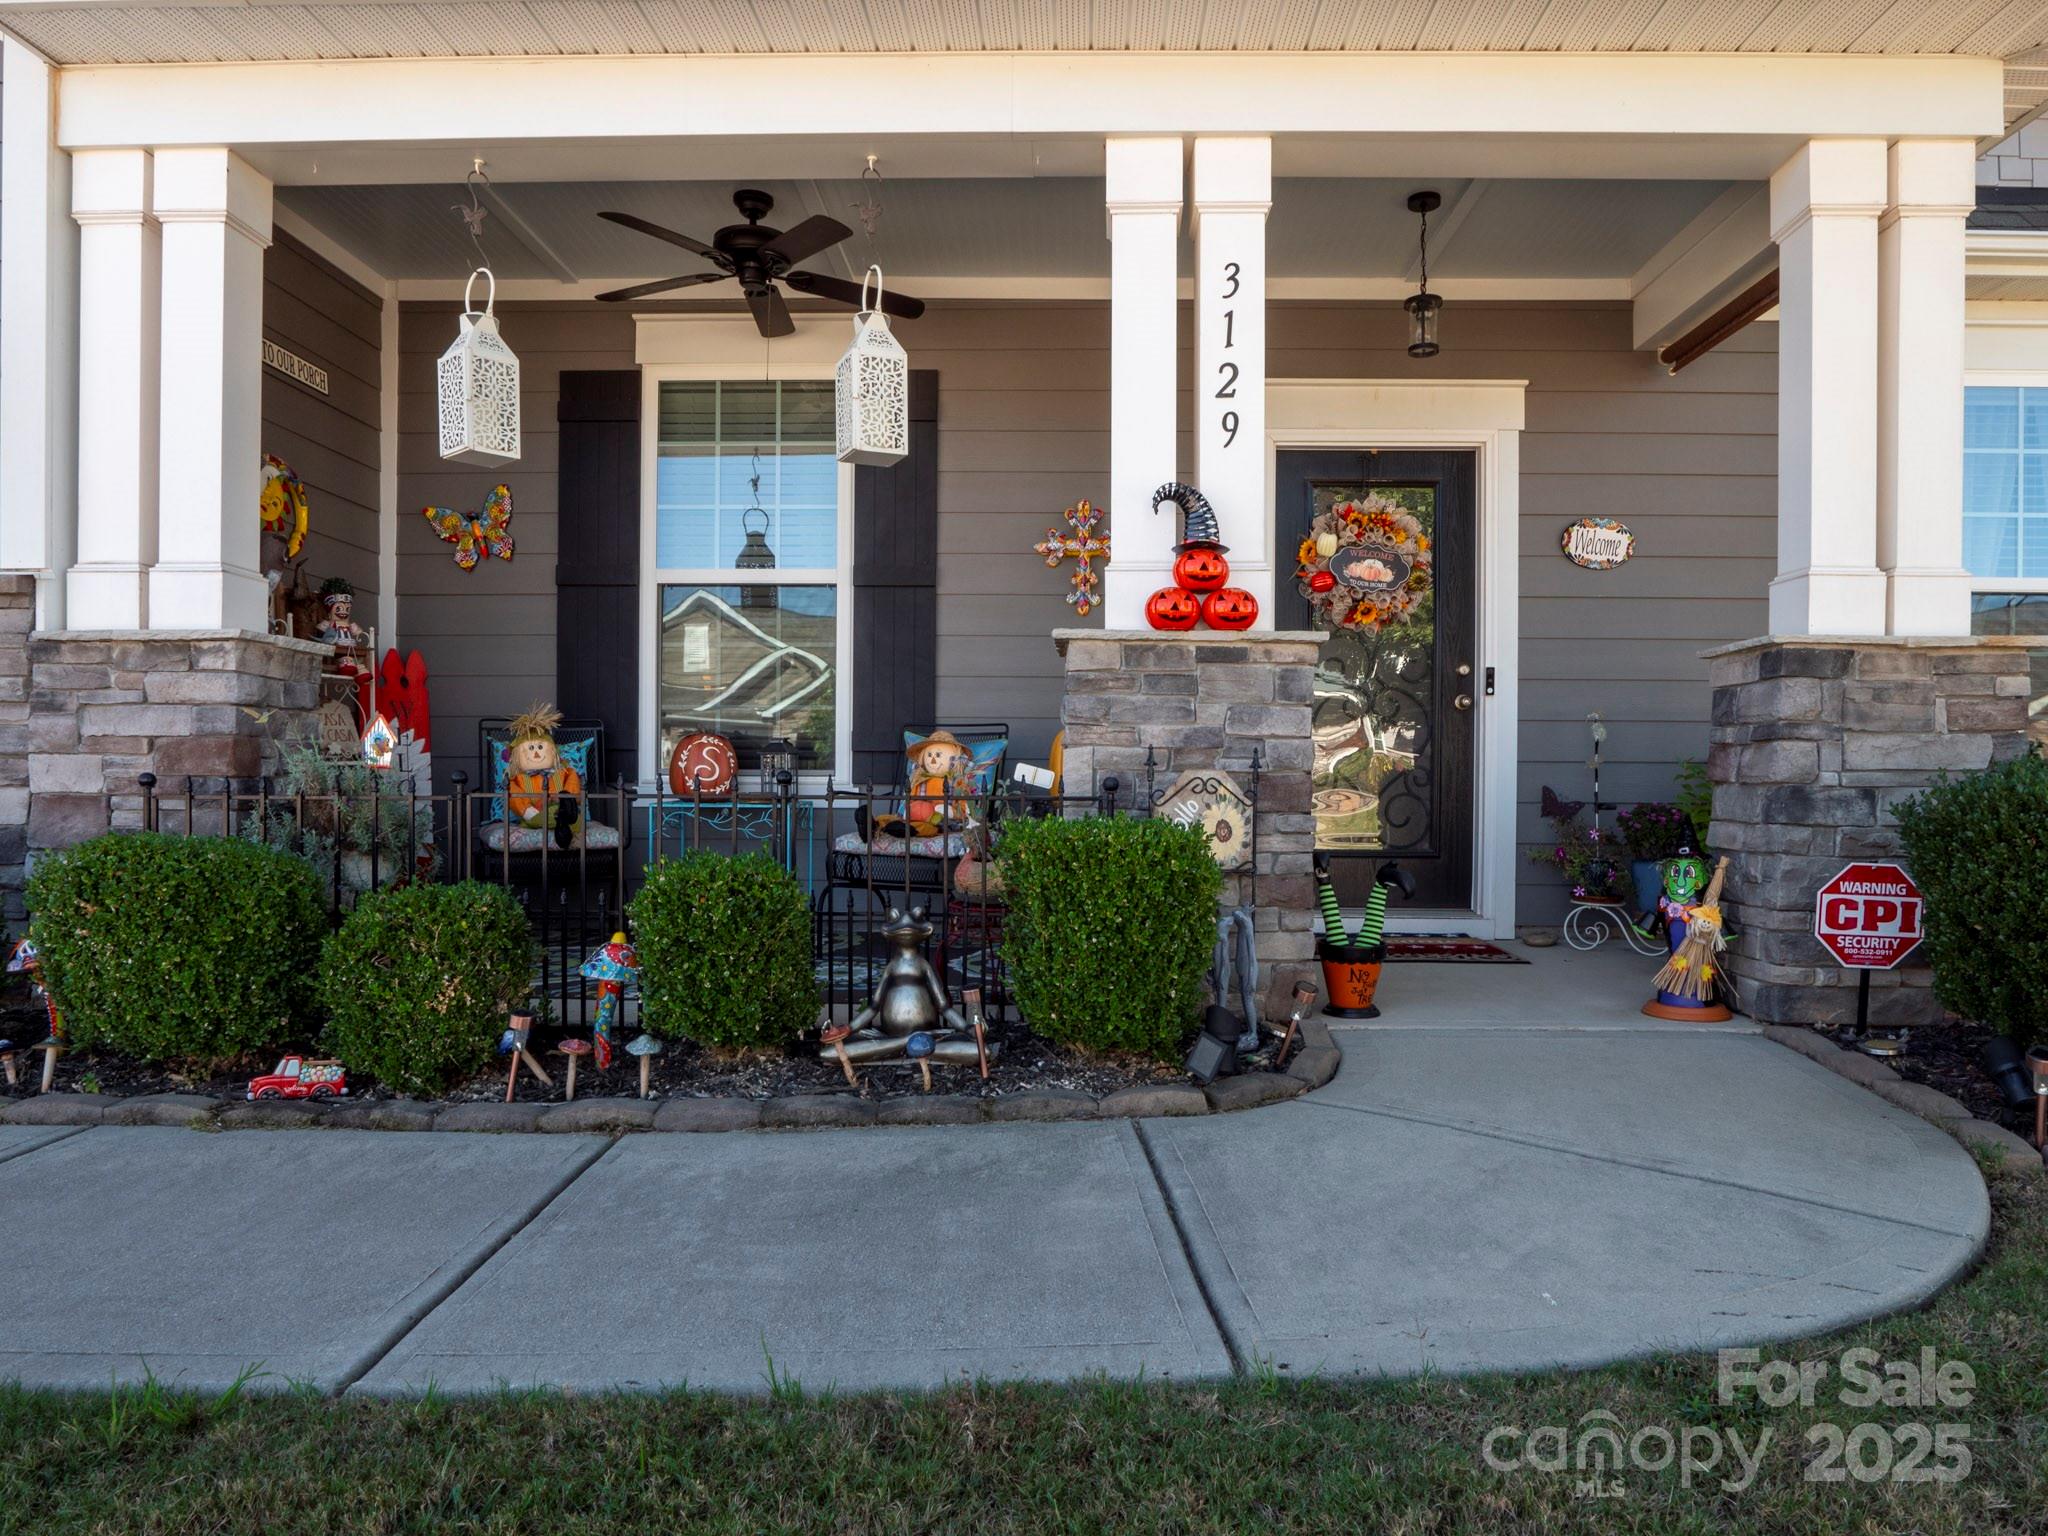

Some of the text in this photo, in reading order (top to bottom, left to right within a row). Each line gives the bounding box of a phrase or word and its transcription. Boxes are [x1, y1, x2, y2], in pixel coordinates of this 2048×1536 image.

[1215, 262, 1240, 448] 3129
[276, 349, 295, 376] OUR
[298, 360, 326, 391] PORCH
[1575, 529, 1621, 557] Welcome
[1350, 549, 1394, 561] WELCOME
[317, 712, 346, 726] ASA
[1840, 881, 1907, 895] WARNING
[1825, 898, 1919, 933] CPI
[1837, 936, 1900, 949] SECURITY
